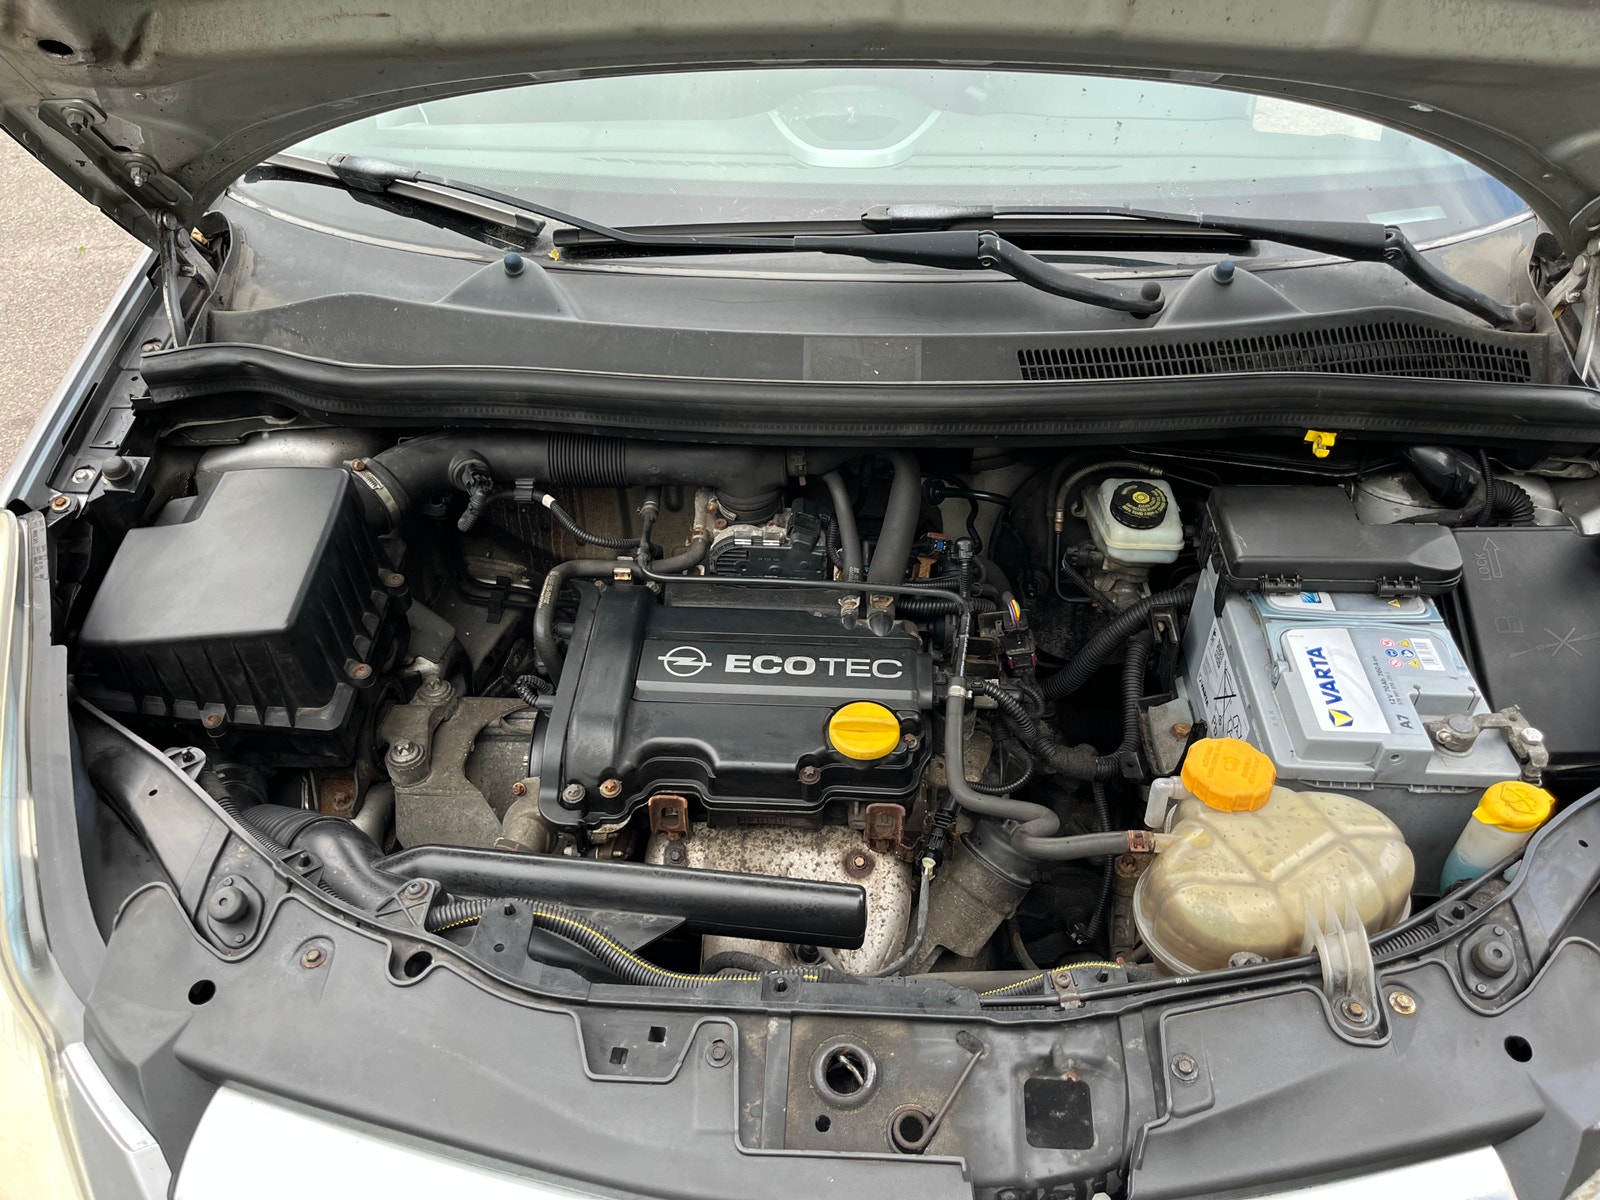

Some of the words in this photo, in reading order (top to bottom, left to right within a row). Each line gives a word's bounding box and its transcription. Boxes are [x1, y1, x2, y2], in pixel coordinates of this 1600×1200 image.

[1474, 552, 1491, 580] LOCK
[725, 654, 903, 679] ECOTEC
[1306, 646, 1343, 705] VARTA
[1396, 714, 1414, 729] A7
